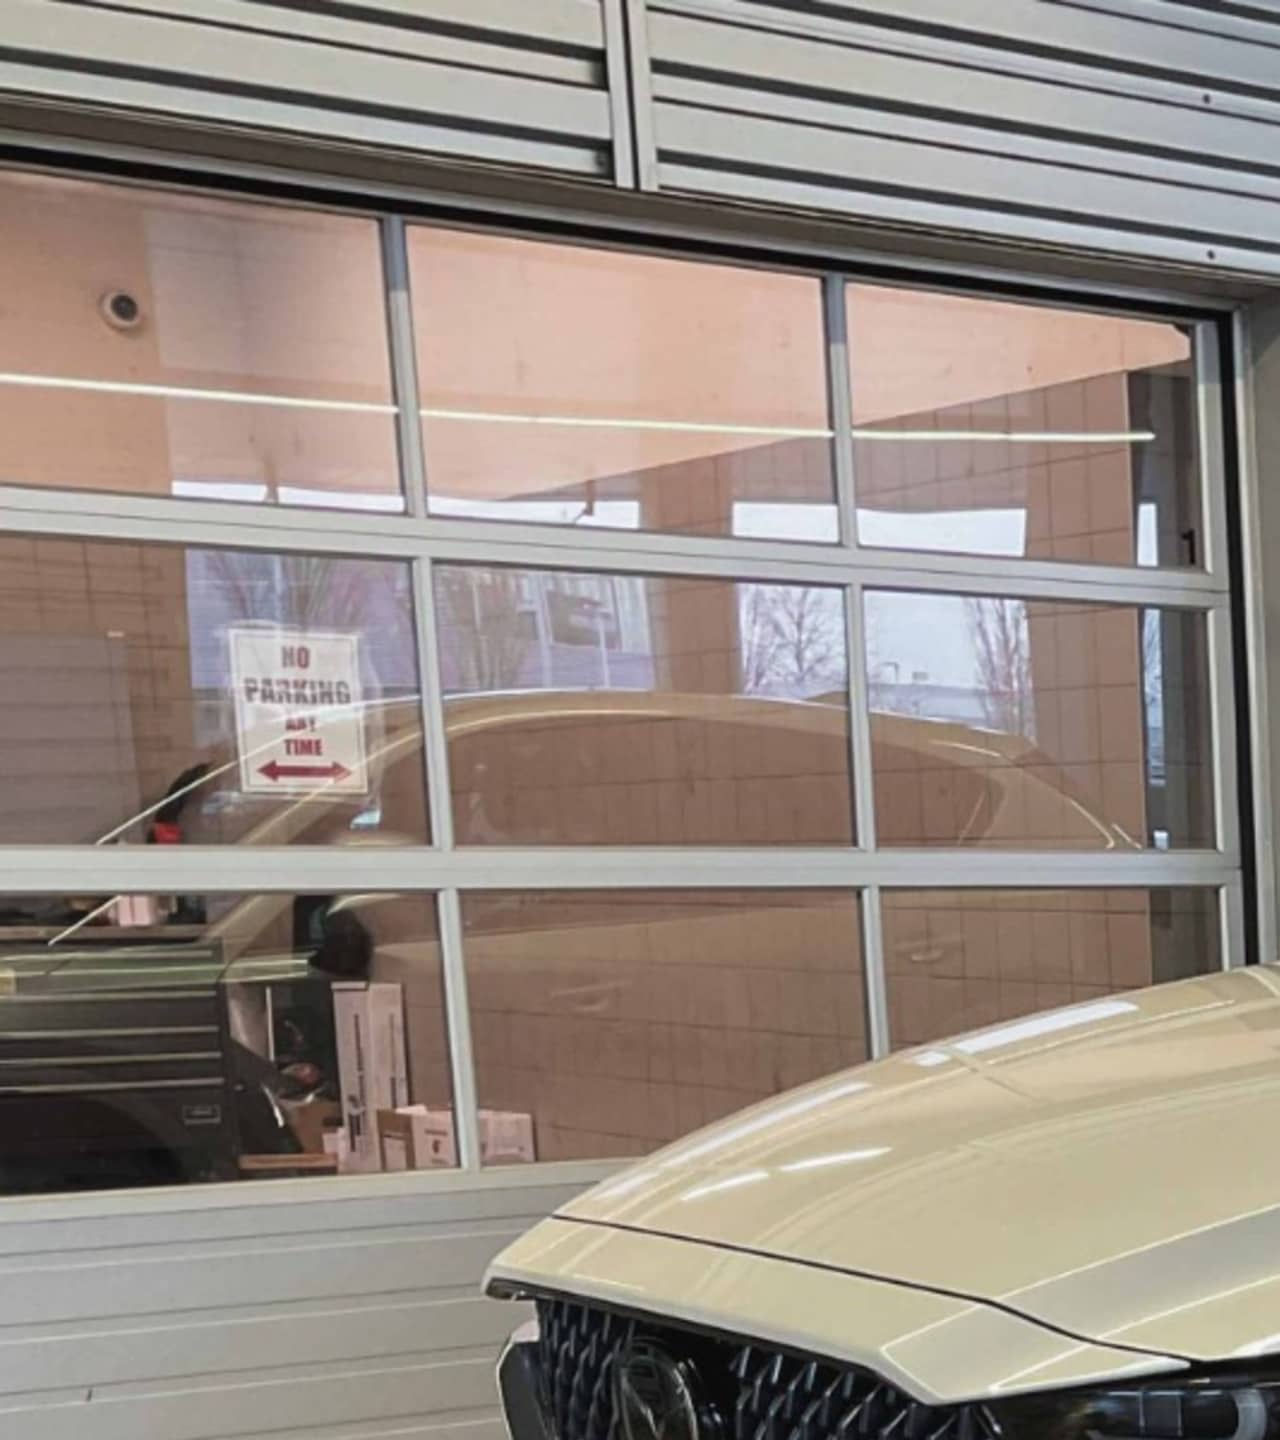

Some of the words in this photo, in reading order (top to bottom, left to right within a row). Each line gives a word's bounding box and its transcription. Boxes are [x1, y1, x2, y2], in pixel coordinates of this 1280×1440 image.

[281, 645, 310, 669] NO
[244, 677, 352, 705] PARKING
[283, 738, 323, 756] TIME
